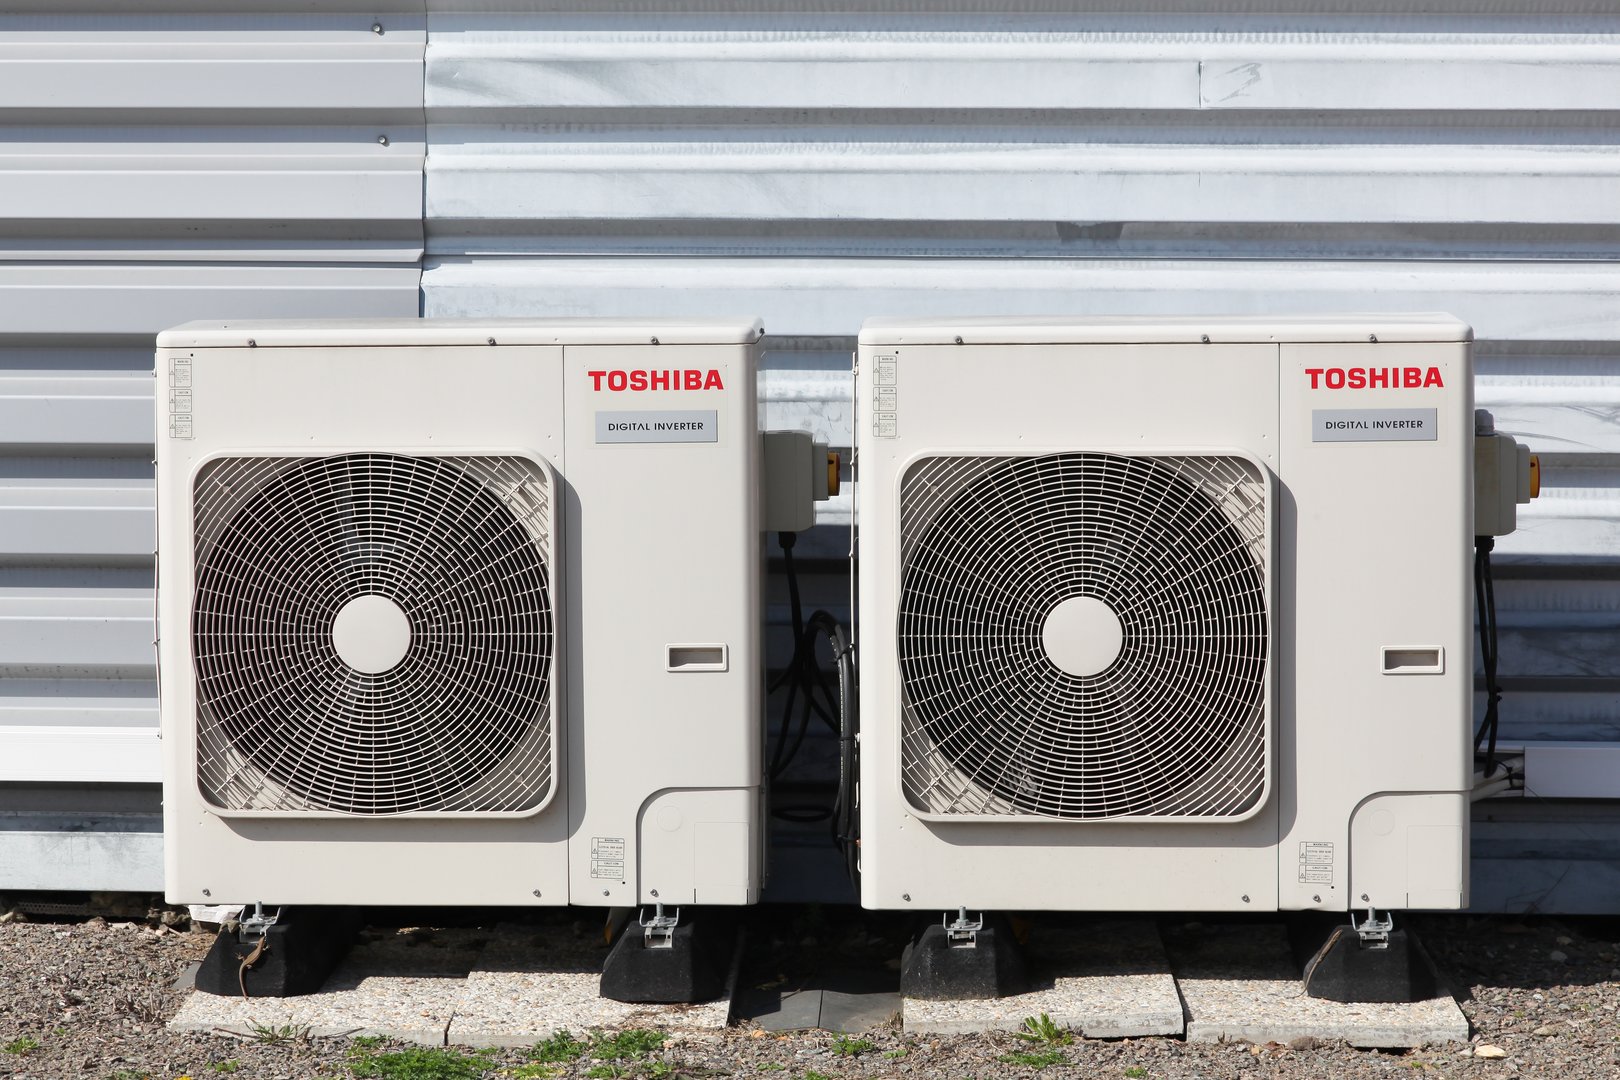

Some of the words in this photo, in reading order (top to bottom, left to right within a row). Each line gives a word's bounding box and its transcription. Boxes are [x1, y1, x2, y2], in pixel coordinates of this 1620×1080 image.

[588, 369, 724, 391] TOSHIBA
[1305, 367, 1444, 389] TOSHIBA
[608, 422, 650, 431] DIGITAL
[654, 422, 704, 431] INVERTER
[1325, 421, 1368, 430] DIGITAL
[1372, 420, 1424, 429] INVERTER
